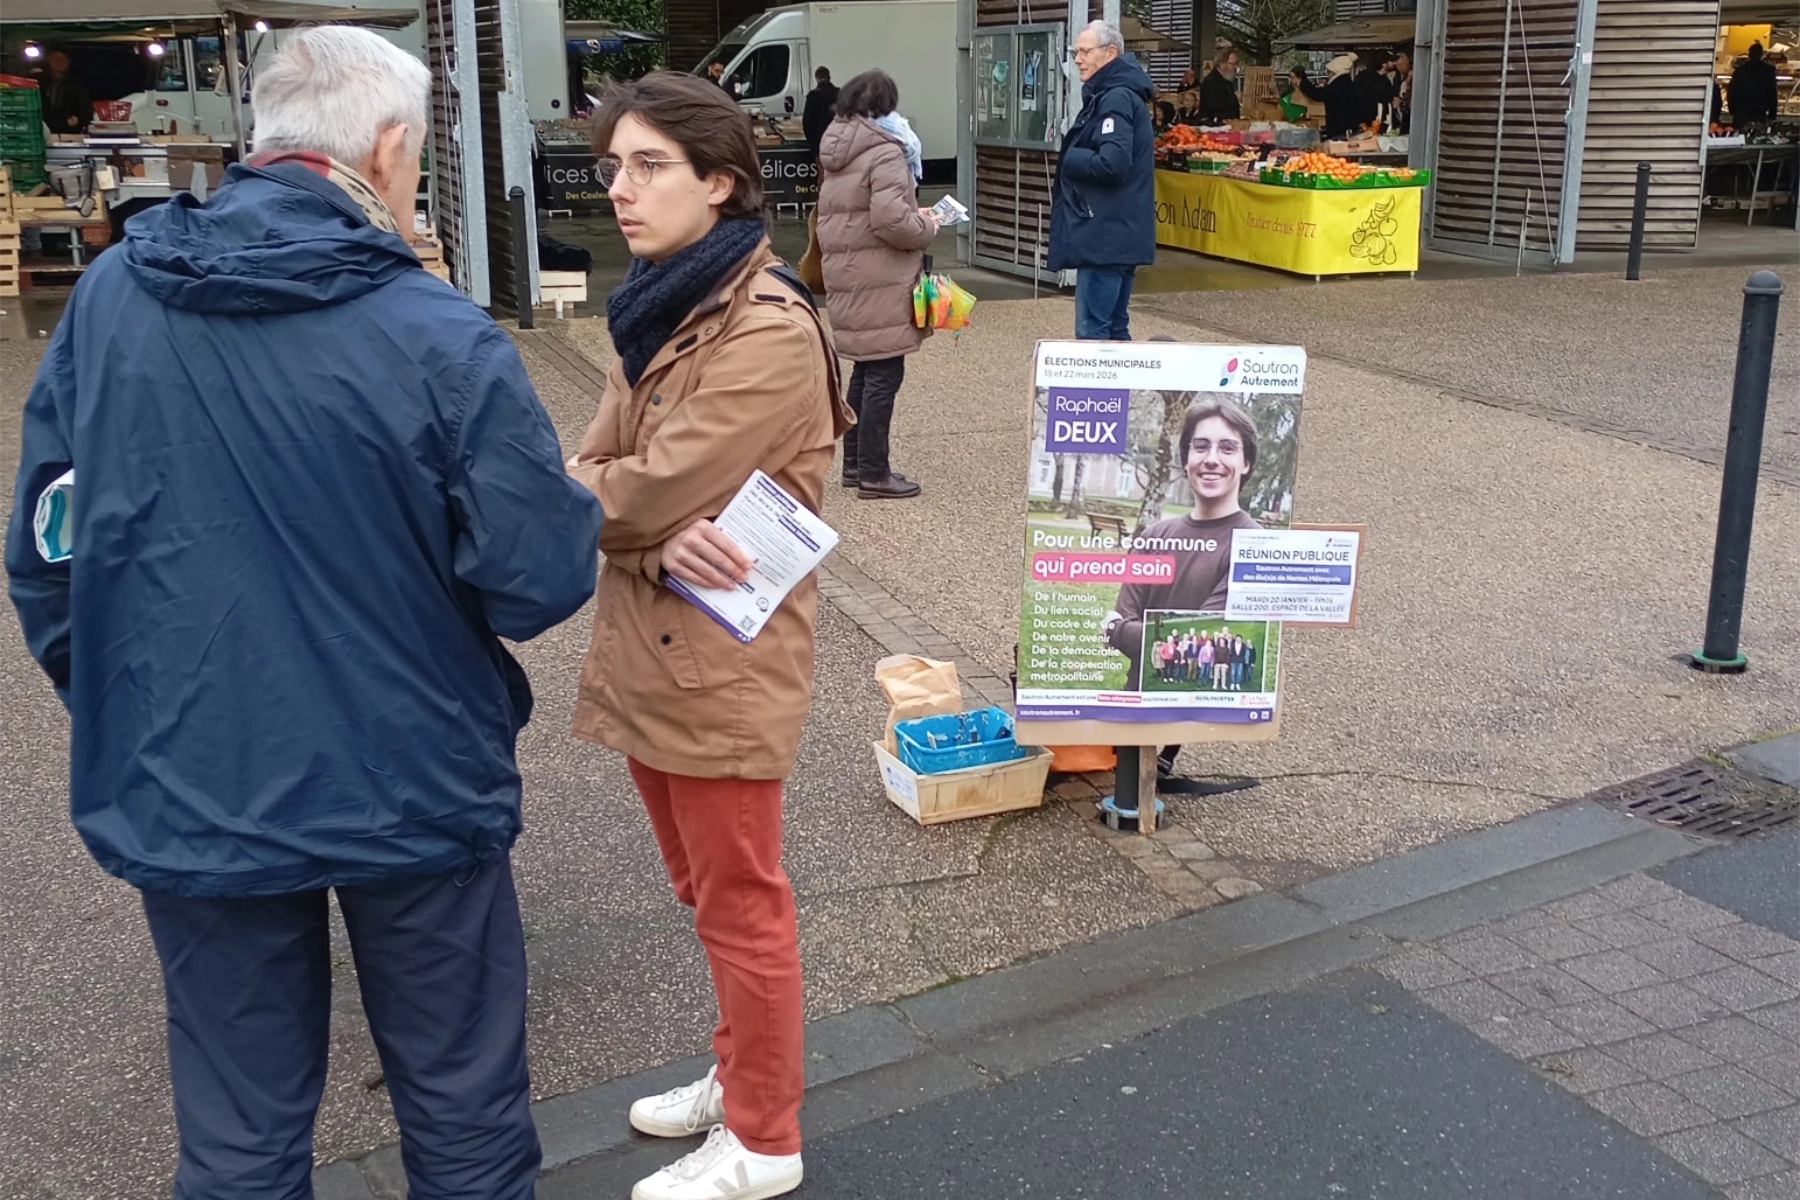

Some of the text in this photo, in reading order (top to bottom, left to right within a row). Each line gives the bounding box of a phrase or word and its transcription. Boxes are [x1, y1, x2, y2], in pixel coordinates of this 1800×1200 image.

[1182, 195, 1217, 233] Adam
[1272, 216, 1294, 237] depuis
[1296, 221, 1318, 238] 1977
[1044, 354, 1162, 370] ÉLECTIONS MUNICIPALES
[1242, 359, 1299, 375] Sautron
[1044, 369, 1118, 380] 15 et 22 mars 2026
[1240, 375, 1298, 387] Autrement
[1055, 396, 1122, 416] Raphaël
[1053, 420, 1118, 443] DEUX
[1033, 530, 1218, 552] Pour une commune
[1238, 546, 1350, 561] RÉUNION PUBLIQUE
[1034, 556, 1172, 579] qui prend soin
[1034, 591, 1096, 603] De l'humain
[1034, 605, 1104, 616] Du lien social
[1033, 618, 1048, 628] Du
[1050, 619, 1080, 629] cadre
[1083, 620, 1097, 630] de
[1032, 632, 1111, 643] De notre avenir
[1031, 645, 1047, 655] De
[1049, 645, 1059, 655] la
[1031, 658, 1046, 668] De
[1047, 659, 1058, 669] la
